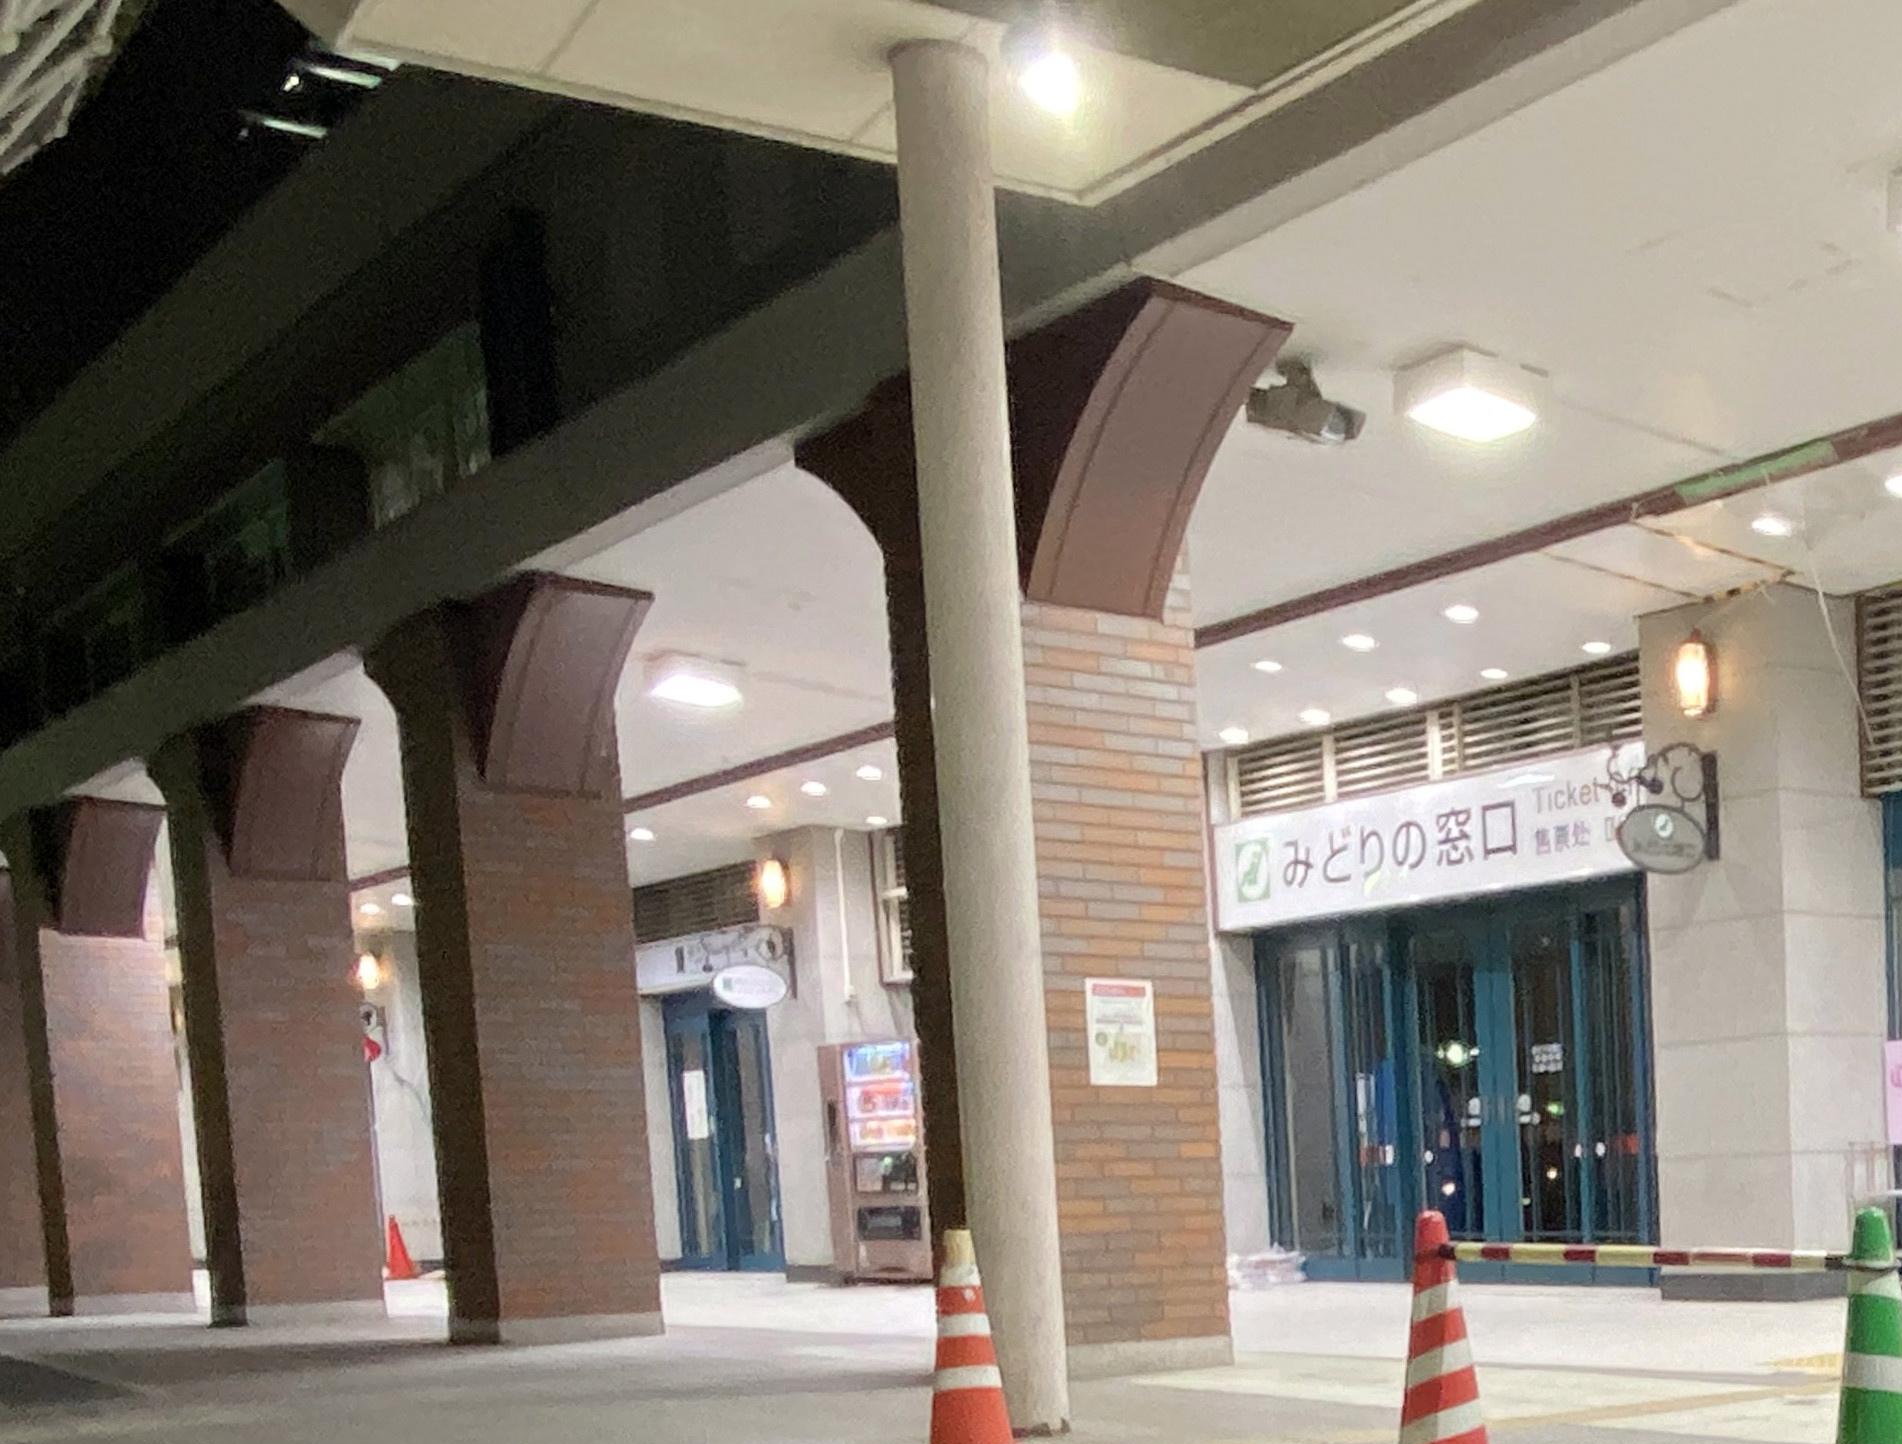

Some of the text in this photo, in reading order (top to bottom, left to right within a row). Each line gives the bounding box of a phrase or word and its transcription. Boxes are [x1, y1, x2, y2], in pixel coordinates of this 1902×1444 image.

[1533, 777, 1600, 814] Ticket
[1282, 801, 1518, 888] みどりの窓口
